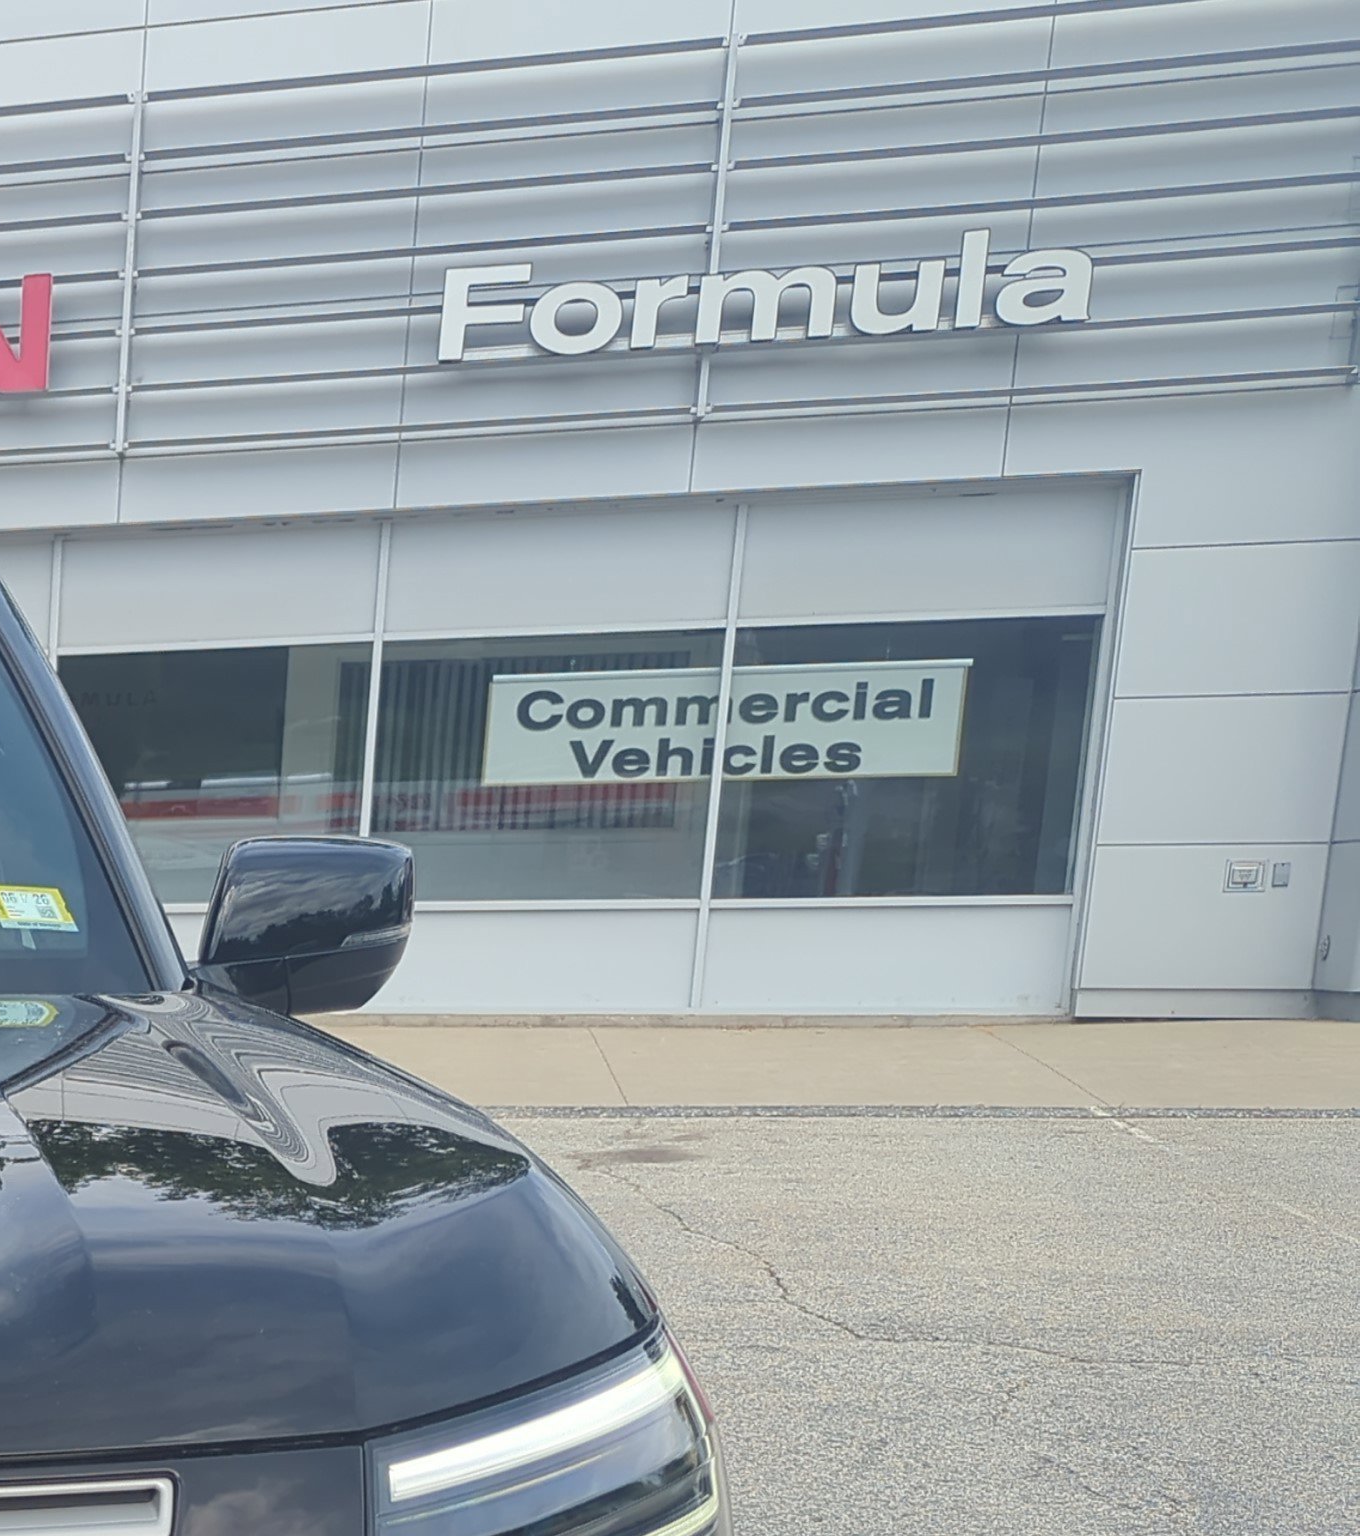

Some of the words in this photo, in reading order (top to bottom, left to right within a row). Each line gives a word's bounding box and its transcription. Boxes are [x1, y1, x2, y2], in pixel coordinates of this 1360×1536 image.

[437, 227, 1093, 363] Formula
[516, 678, 935, 731] Commercial
[569, 735, 863, 779] Vehicles
